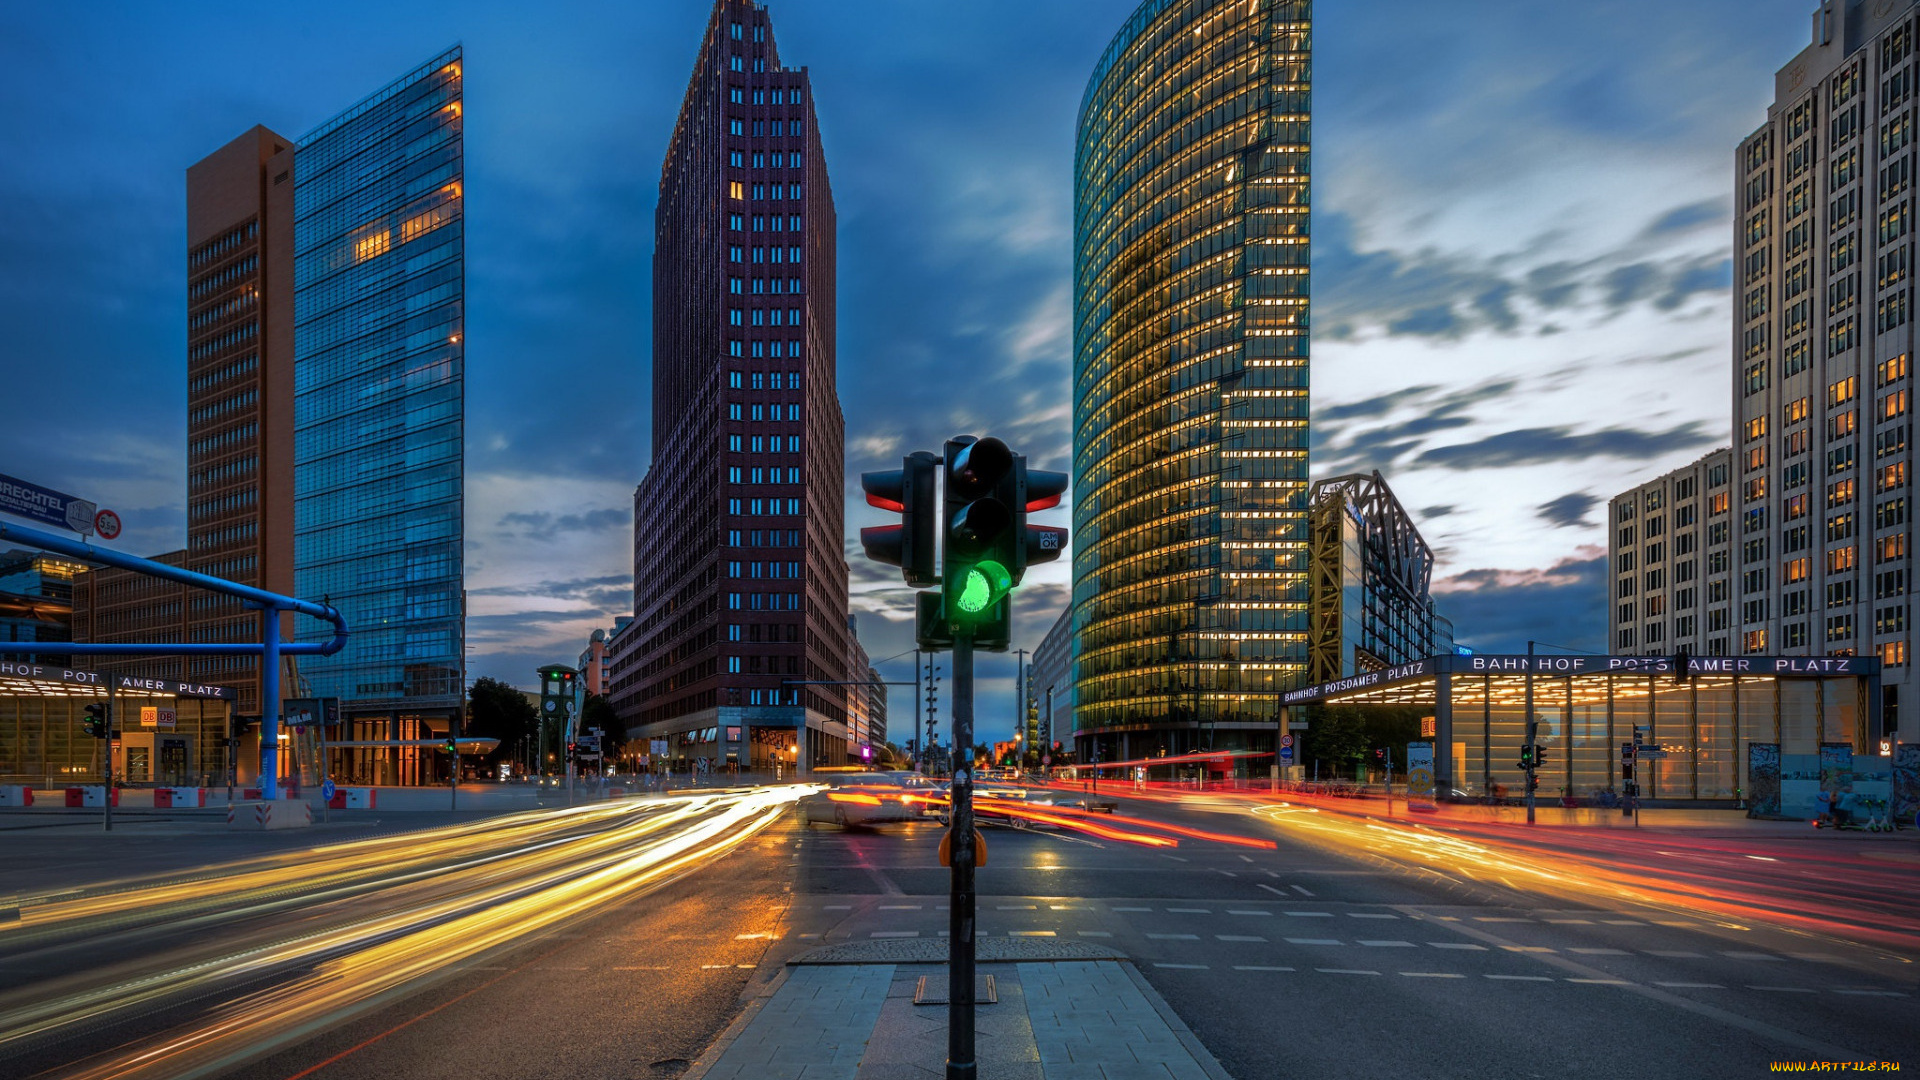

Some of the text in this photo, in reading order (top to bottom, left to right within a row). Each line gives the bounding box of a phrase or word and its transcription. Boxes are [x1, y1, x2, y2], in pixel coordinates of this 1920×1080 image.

[0, 480, 64, 511] RECHTEL
[1043, 540, 1057, 548] OK
[1609, 658, 1750, 671] POTSAMER
[1776, 659, 1850, 672] PLATZ
[64, 670, 164, 690] POTAMER
[179, 683, 222, 697] PLATZ
[1284, 662, 1424, 703] BAHNHOF POTSDAMER PLATZ
[144, 712, 155, 721] DB
[160, 712, 172, 722] DB
